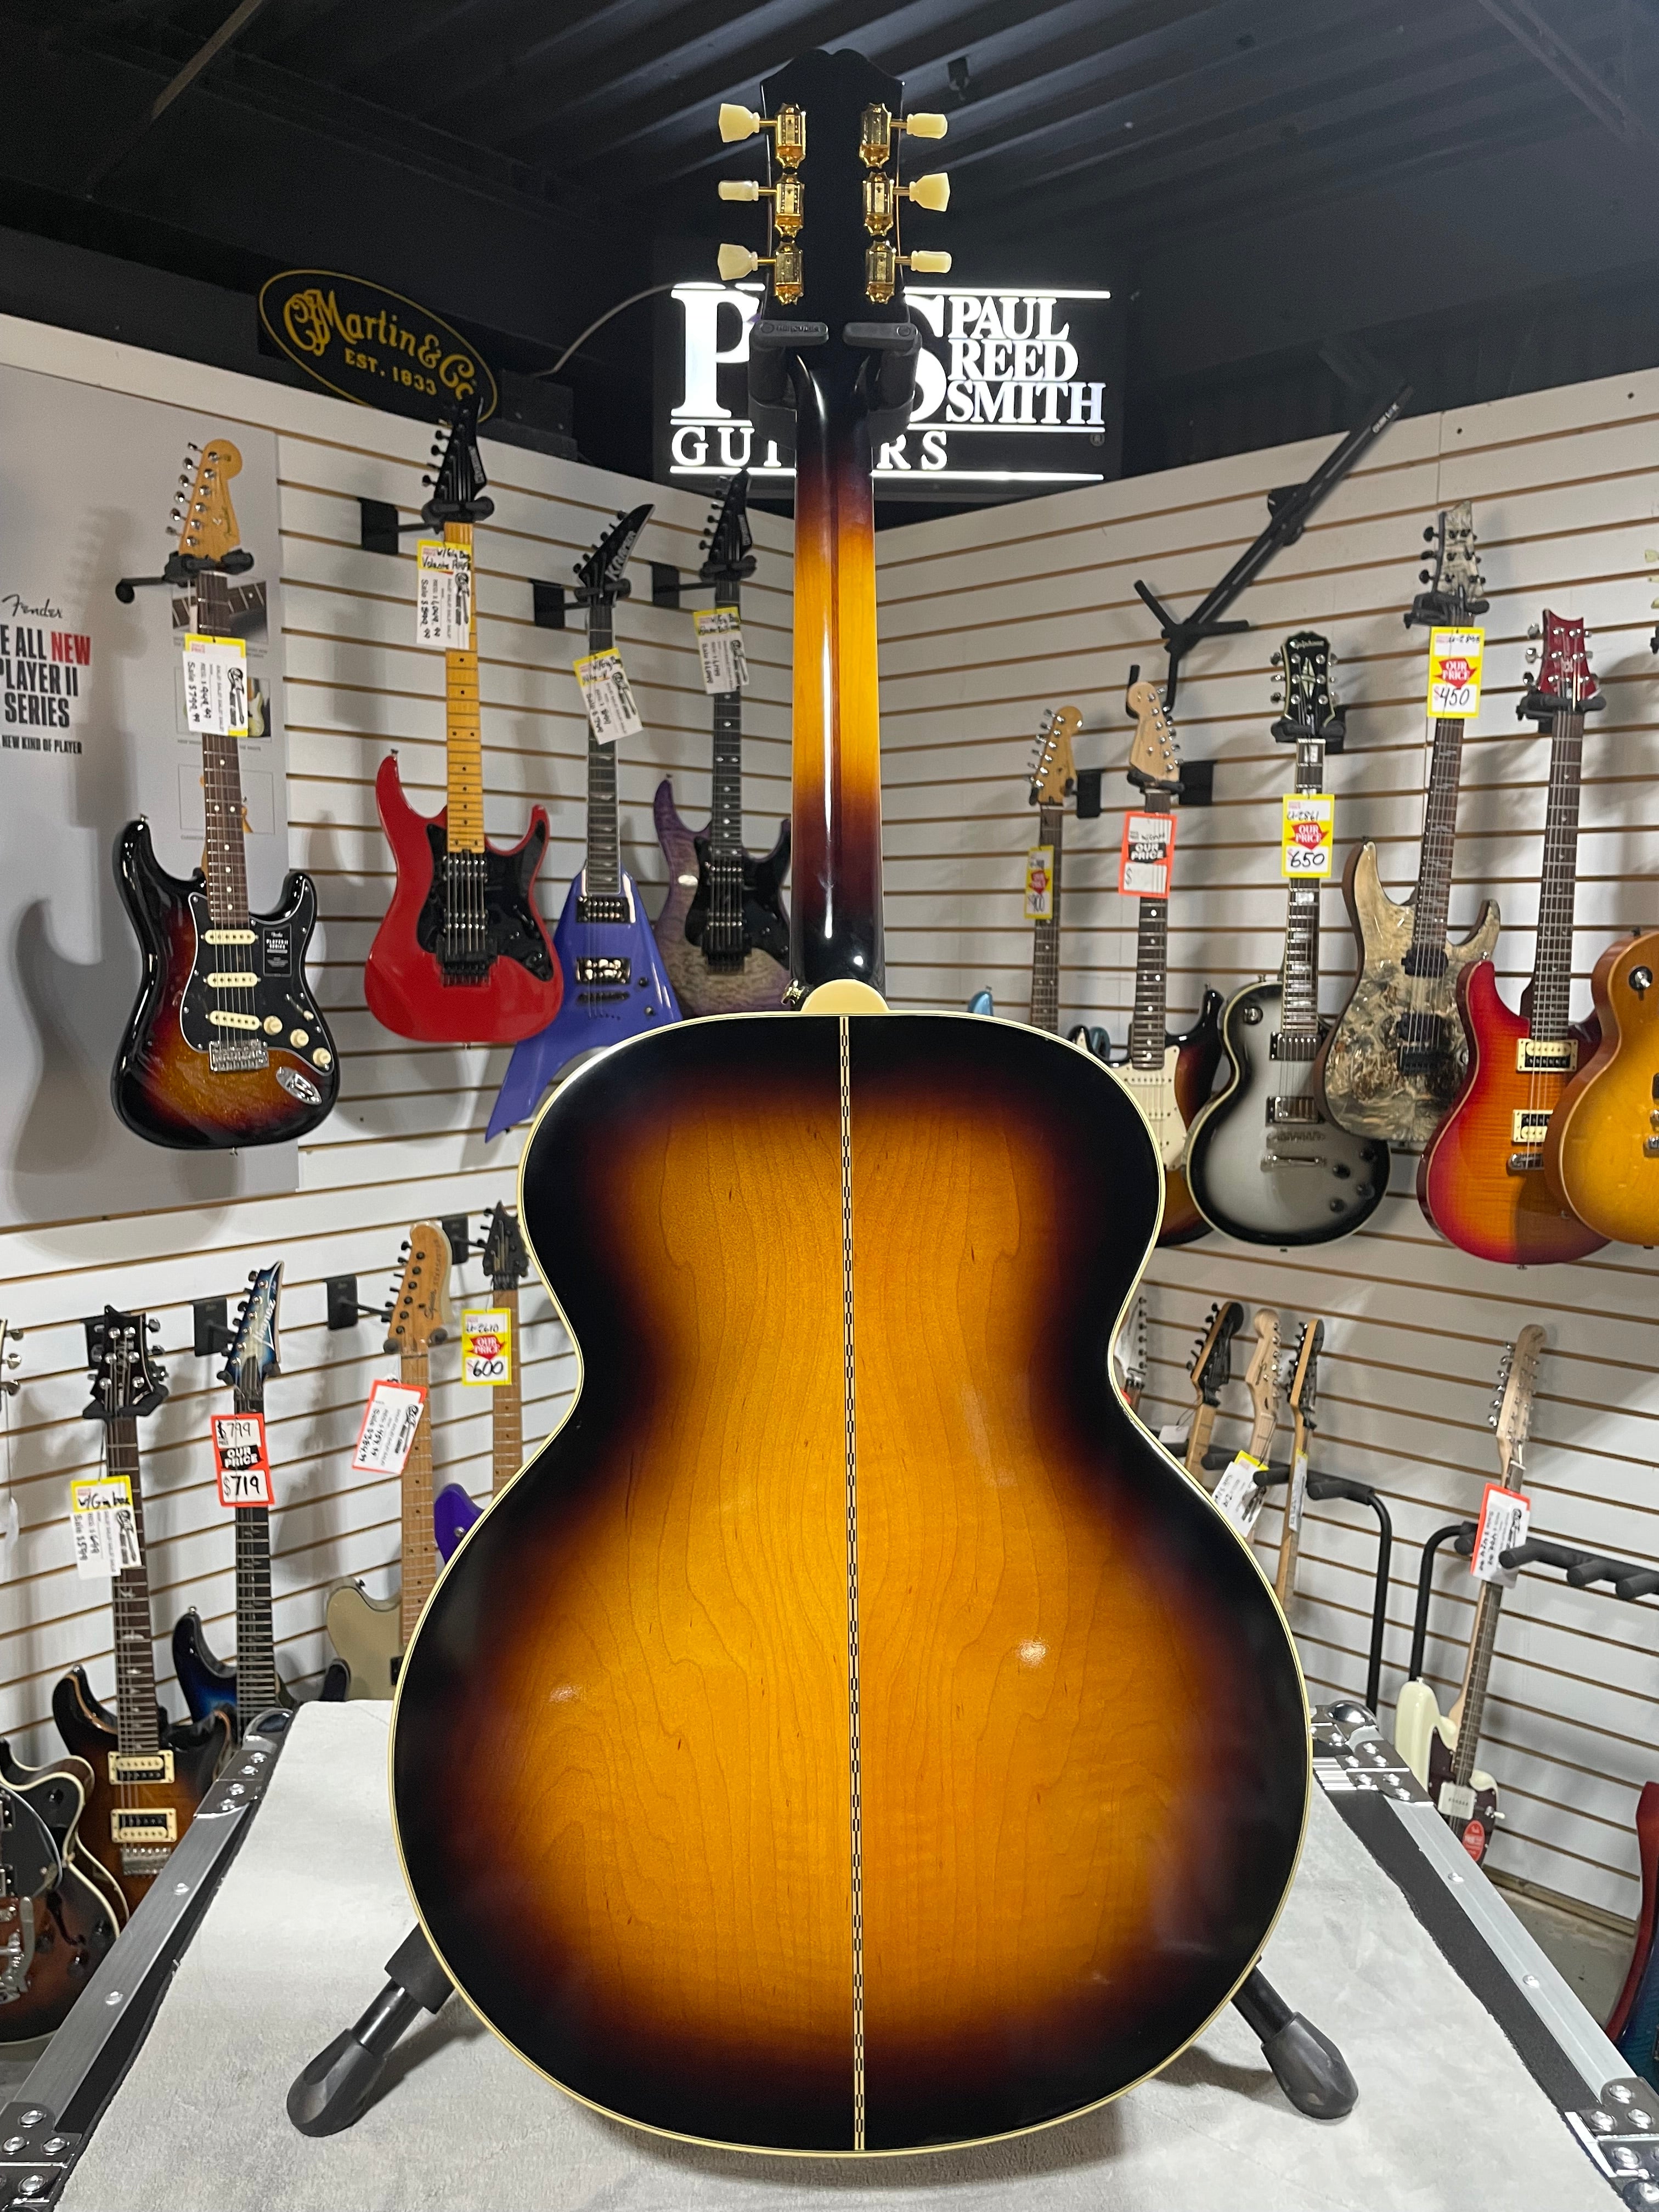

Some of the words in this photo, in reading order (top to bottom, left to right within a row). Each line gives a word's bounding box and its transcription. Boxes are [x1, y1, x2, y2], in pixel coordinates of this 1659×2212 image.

[949, 296, 1070, 340] PAUL
[949, 340, 1079, 381] REED
[344, 348, 386, 377] EST.
[392, 366, 437, 396] 1833
[946, 380, 1105, 425] SMITH
[2, 594, 63, 618] Fender
[16, 627, 47, 660] ALL
[50, 631, 91, 666] NEW
[1442, 670, 1471, 681] PRICE
[1446, 661, 1467, 670] OUR
[65, 665, 79, 697] II
[1434, 686, 1470, 708] $450
[4, 692, 70, 728] SERIES
[2, 735, 20, 749] NEW
[21, 736, 42, 752] KIND
[43, 738, 52, 752] OF
[54, 739, 82, 755] PLAYER
[1295, 833, 1322, 843] PRICE
[1299, 825, 1319, 834] OUR
[1131, 850, 1164, 861] PRICE
[1135, 843, 1159, 853] OUR
[1288, 848, 1325, 868] $650
[474, 1344, 500, 1355] PRICE
[477, 1336, 497, 1346] OUR
[467, 1360, 504, 1378] $600
[224, 1454, 258, 1469] PRICE
[227, 1447, 251, 1458] OUR
[223, 1475, 260, 1498] $719
